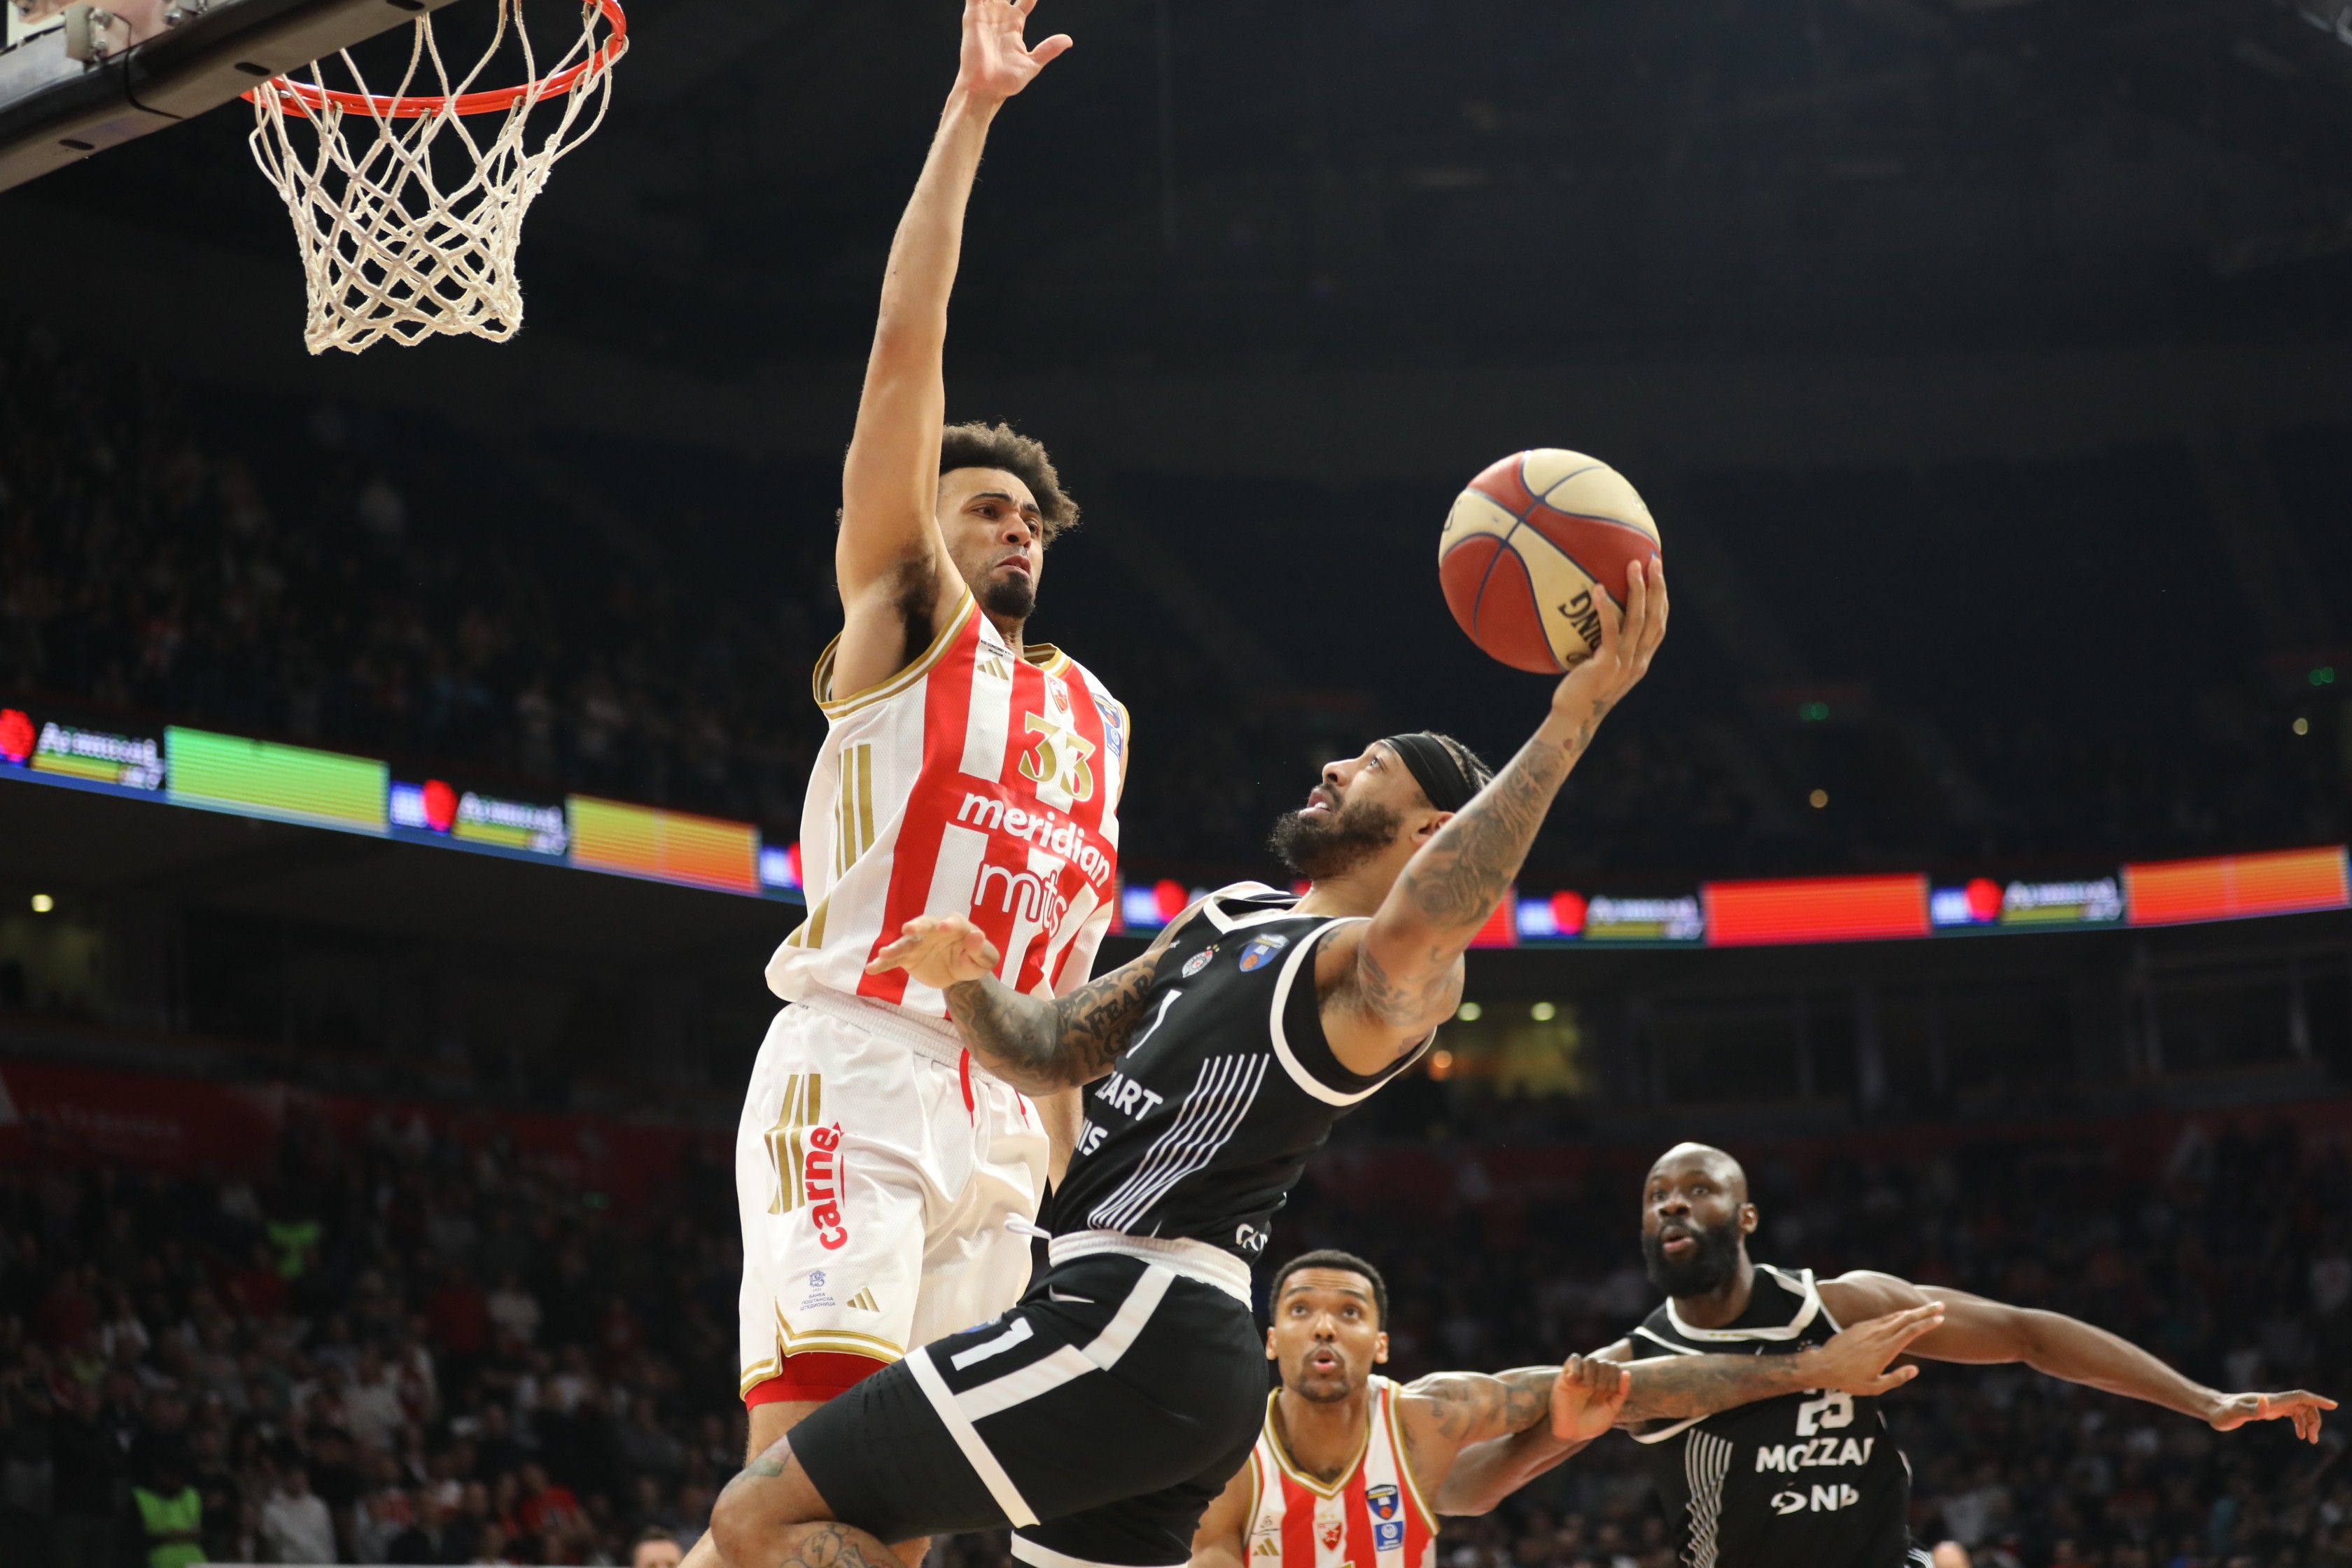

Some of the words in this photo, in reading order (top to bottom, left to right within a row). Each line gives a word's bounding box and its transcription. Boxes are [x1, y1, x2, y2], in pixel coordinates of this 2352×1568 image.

[1018, 710, 1096, 802] 33
[956, 792, 1111, 888] meridian
[974, 863, 1068, 939] mts
[1095, 1071, 1163, 1121] ART
[805, 1122, 848, 1250] carne
[802, 1296, 834, 1306] ПОШТАНСКА
[951, 1317, 1034, 1371] 1
